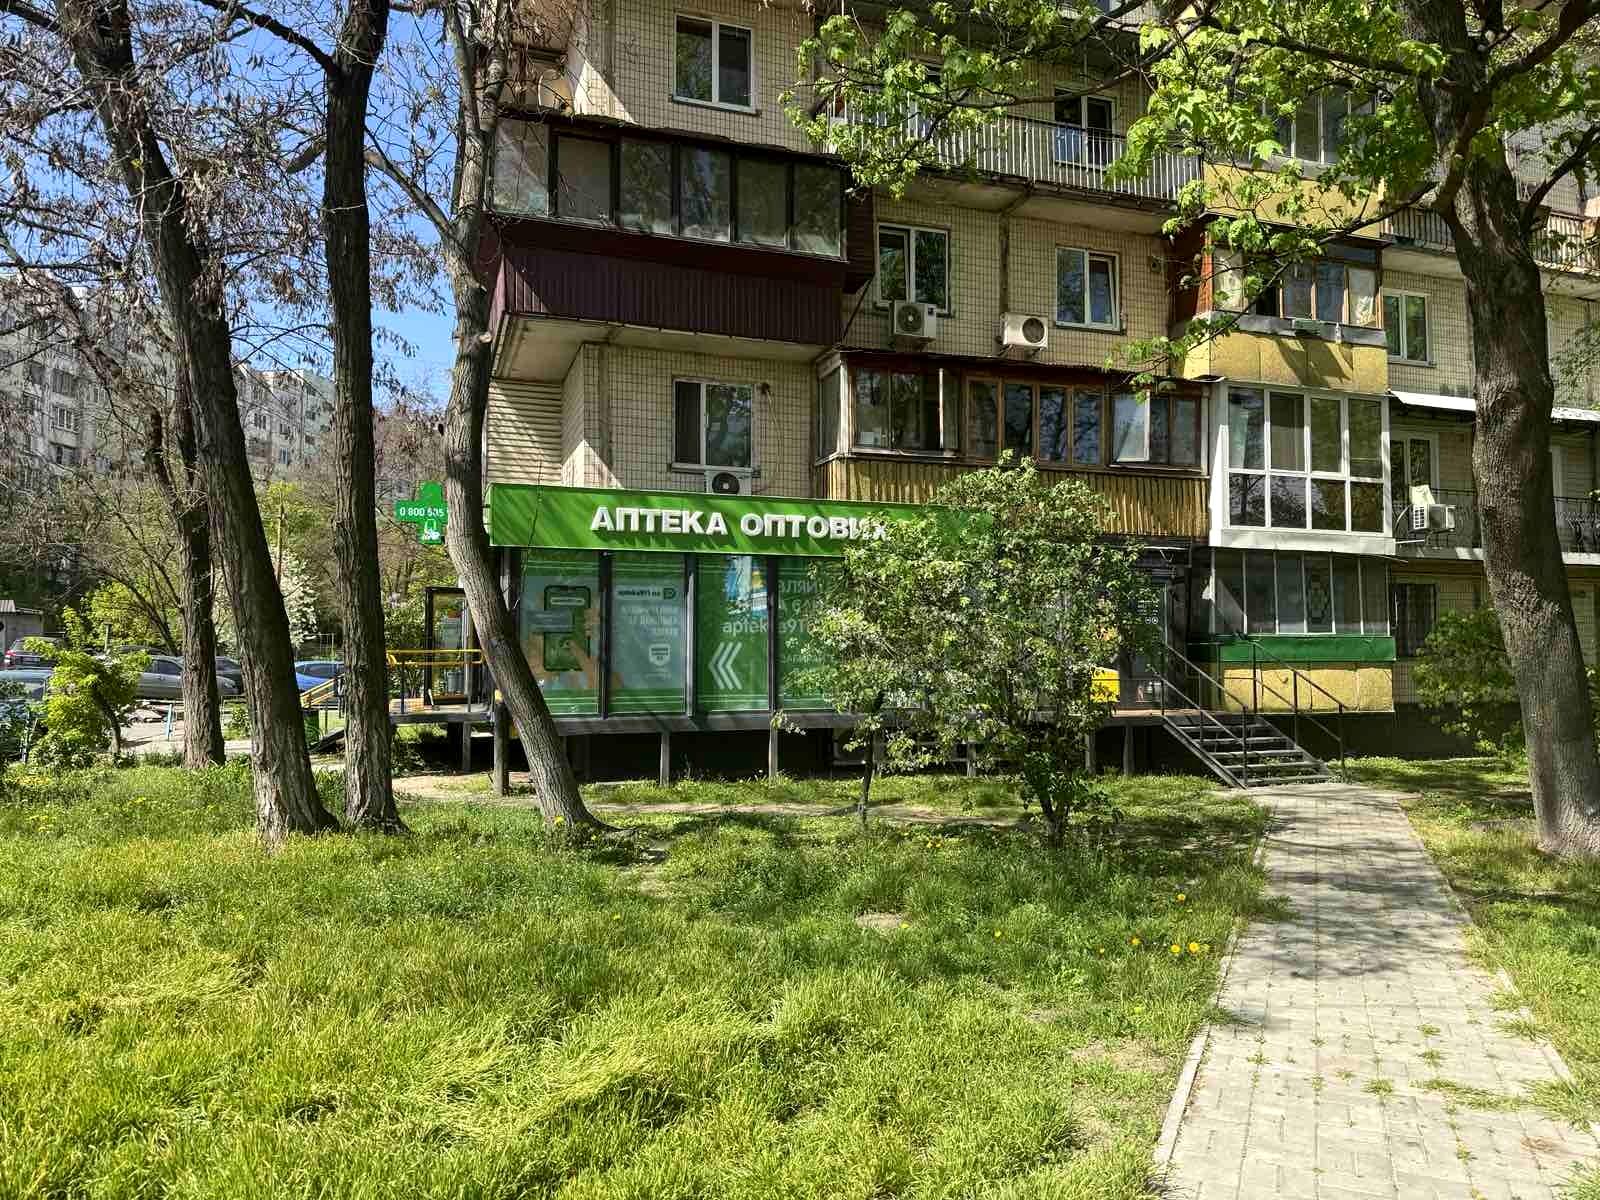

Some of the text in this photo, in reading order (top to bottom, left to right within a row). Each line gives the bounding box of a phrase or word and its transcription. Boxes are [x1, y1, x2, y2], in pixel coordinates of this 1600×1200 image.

[399, 506, 406, 517] 0
[408, 507, 425, 517] 800
[590, 505, 729, 536] АПТЕКА
